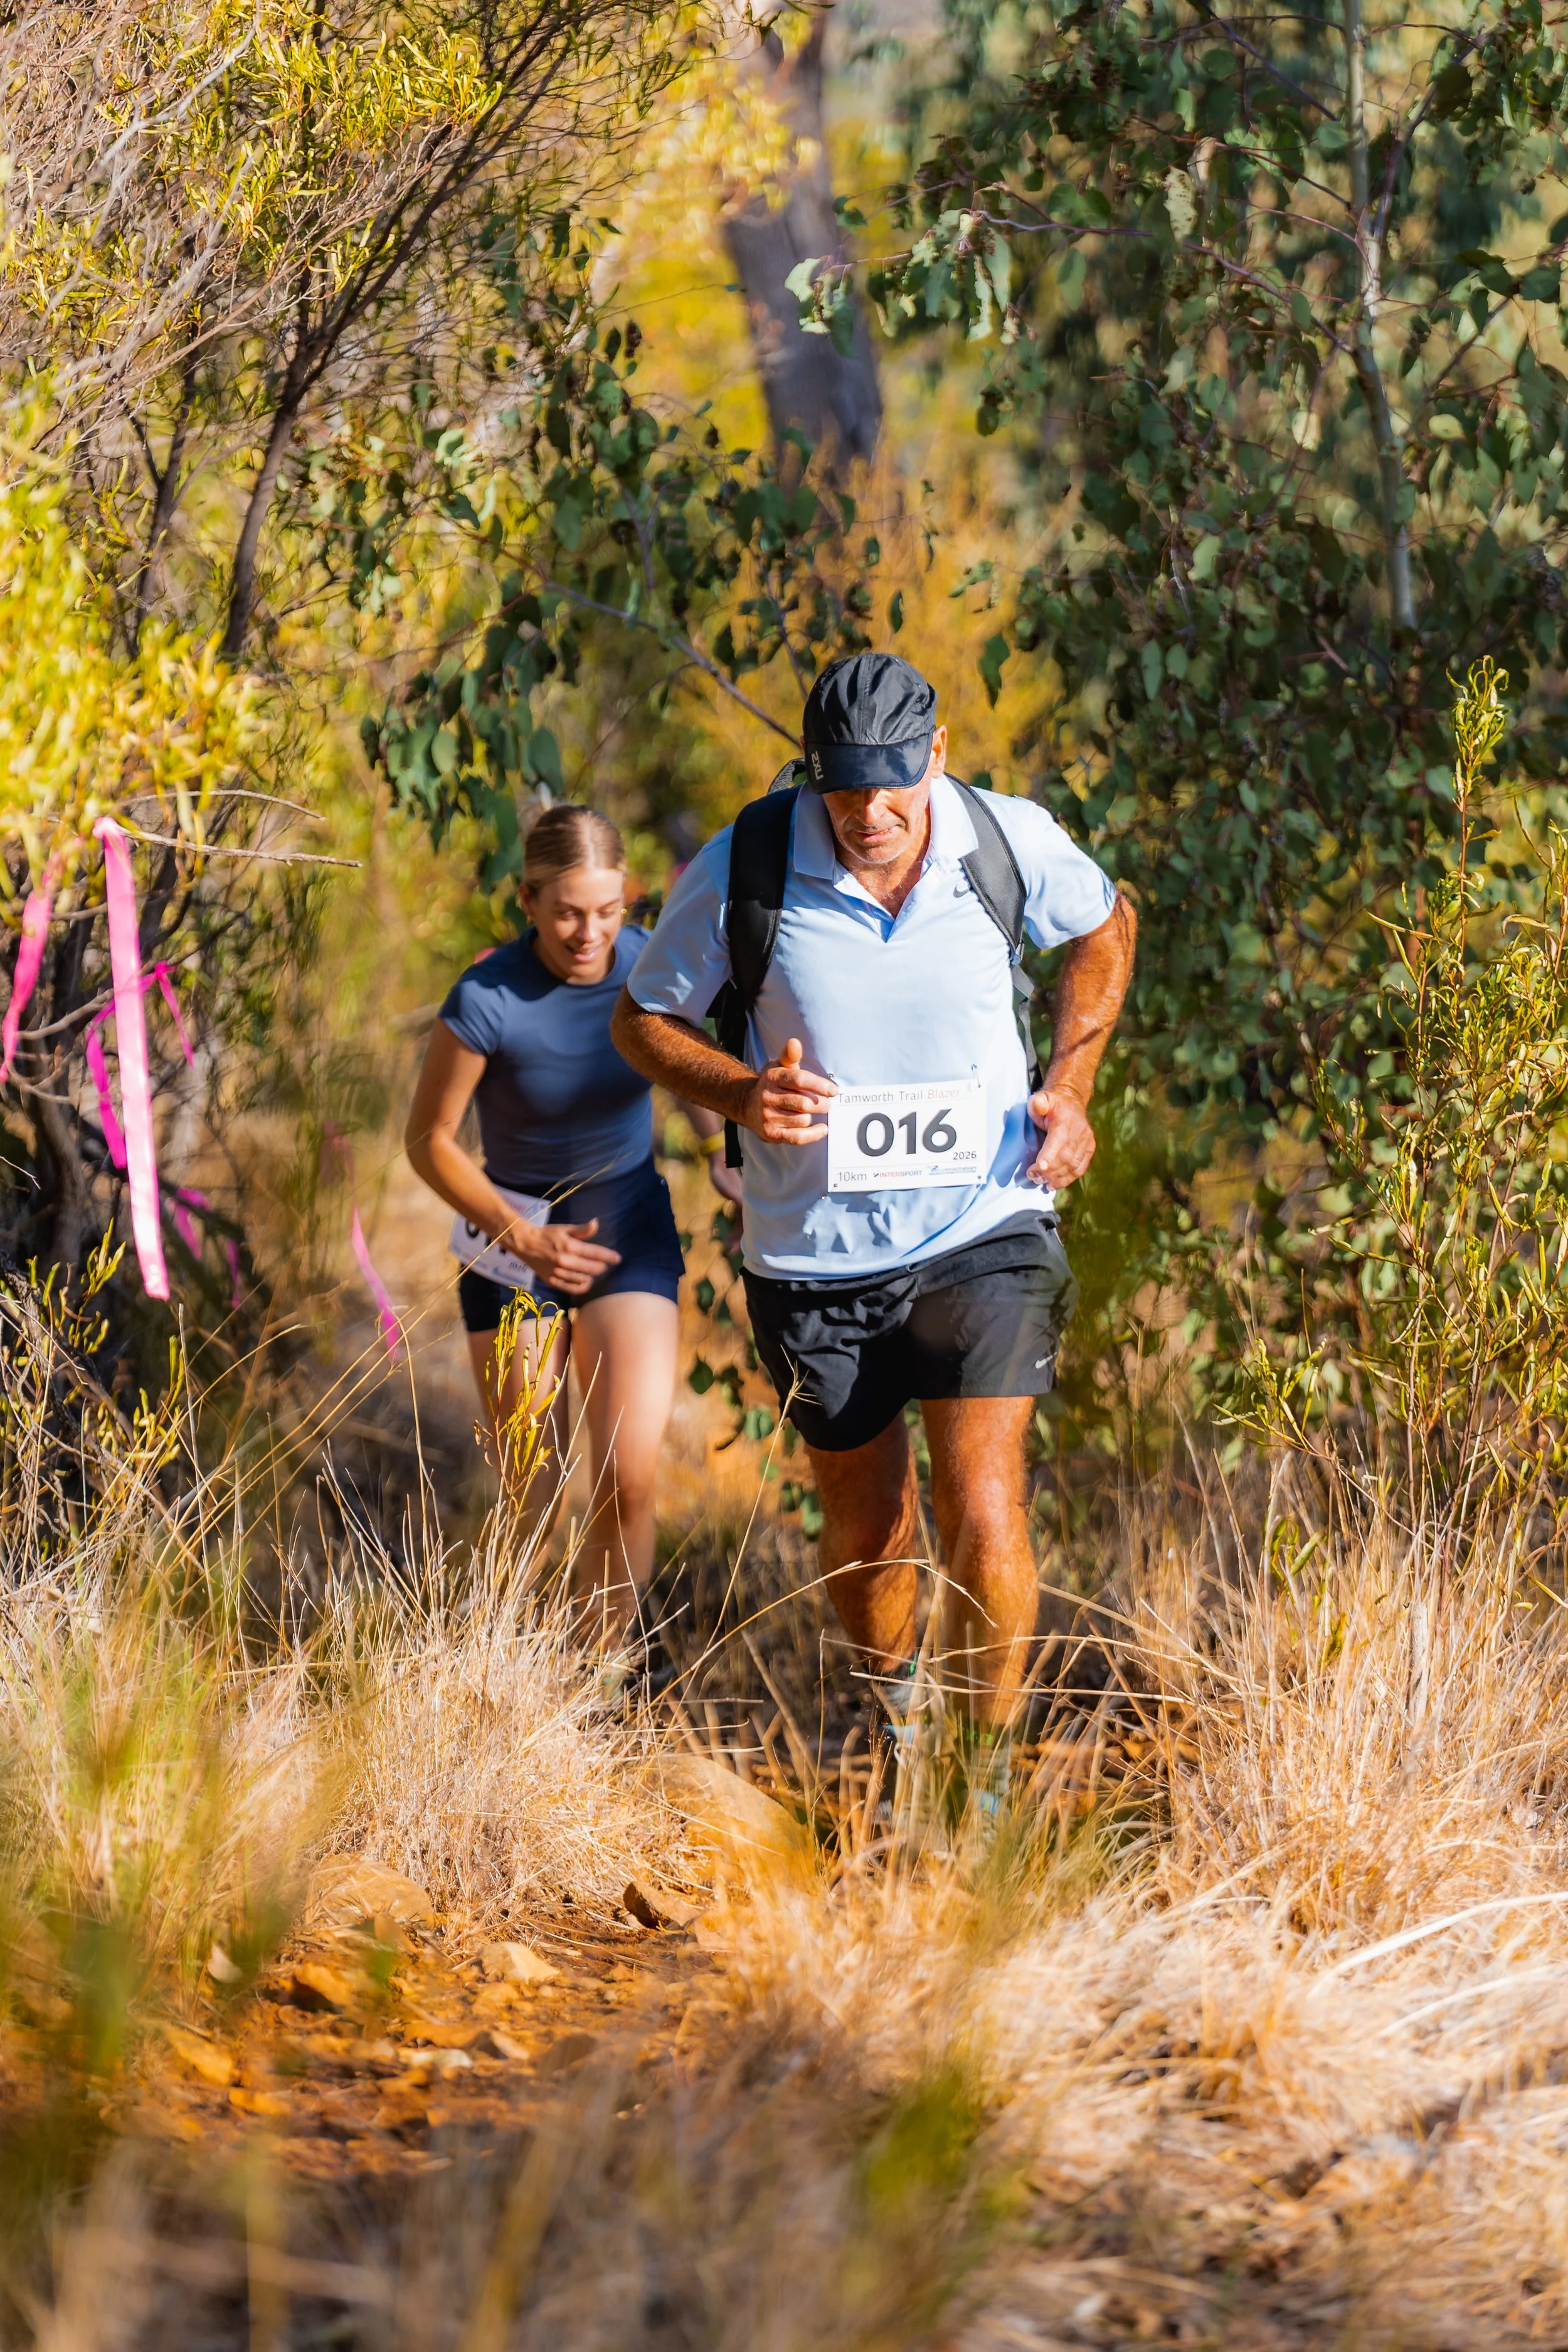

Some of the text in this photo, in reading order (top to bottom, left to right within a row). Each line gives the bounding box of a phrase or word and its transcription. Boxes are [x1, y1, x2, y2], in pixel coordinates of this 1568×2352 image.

[812, 751, 824, 780] 2XU
[838, 1089, 960, 1103] Tamworth Trail Blazer
[857, 1108, 957, 1157] 016
[953, 1151, 977, 1160] 2026
[837, 1171, 867, 1182] 10km
[879, 1170, 923, 1178] INTERSPORT
